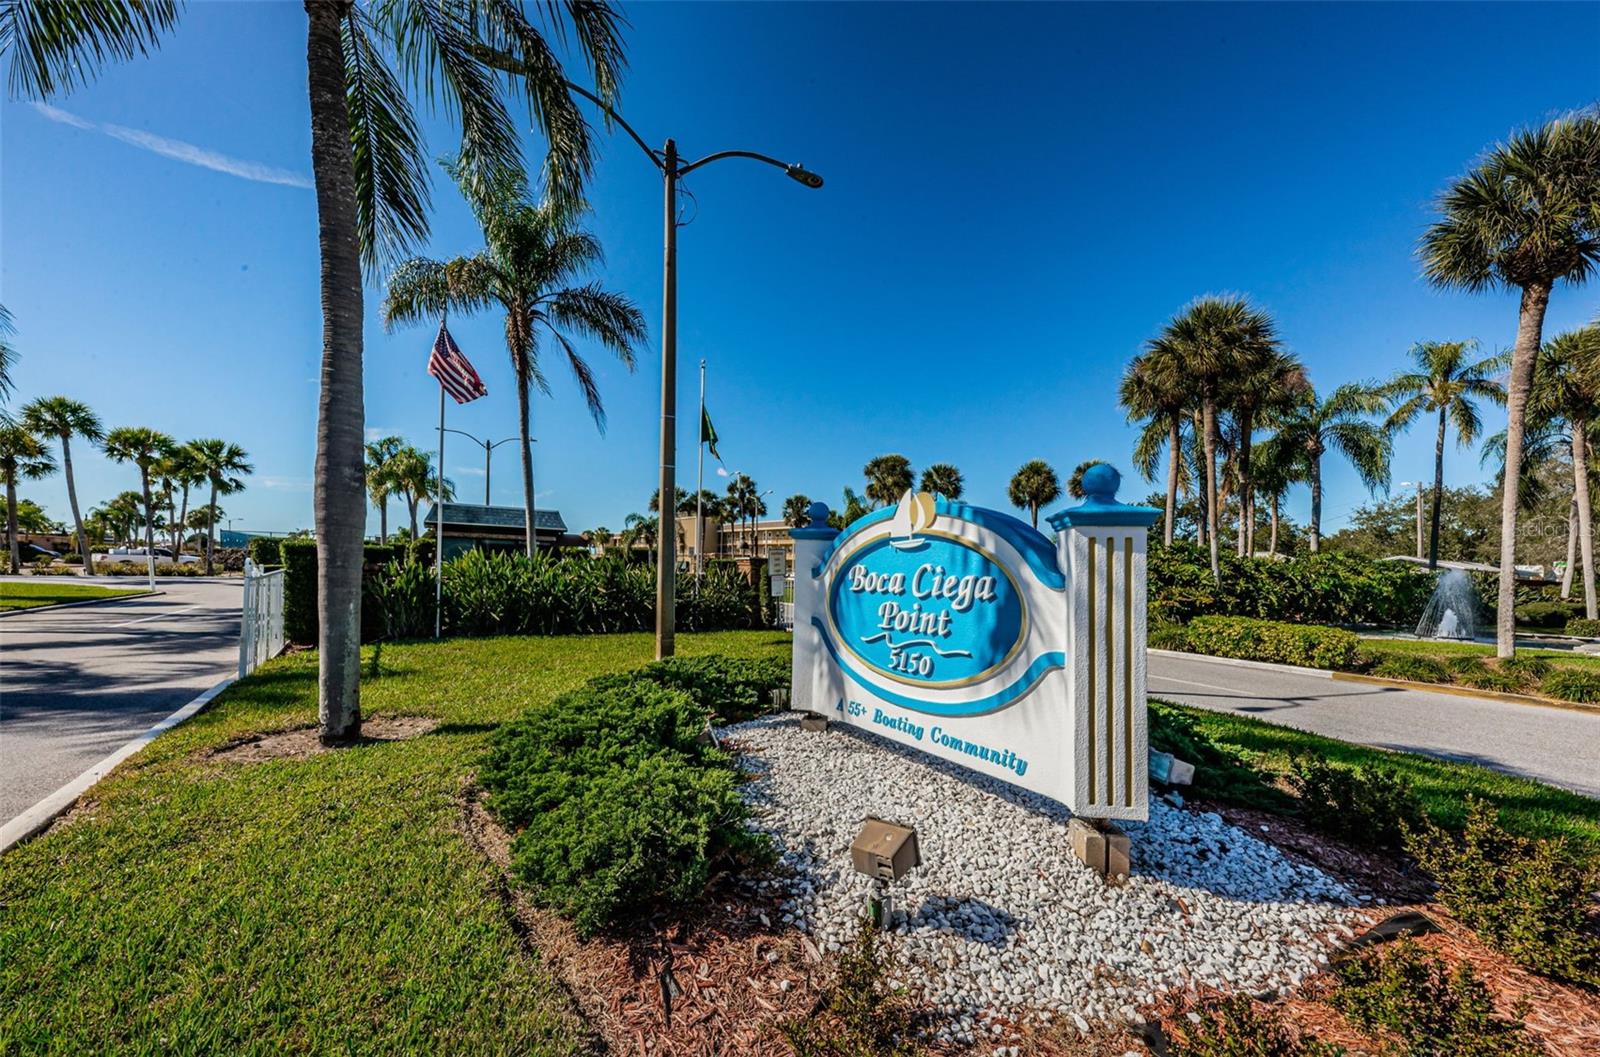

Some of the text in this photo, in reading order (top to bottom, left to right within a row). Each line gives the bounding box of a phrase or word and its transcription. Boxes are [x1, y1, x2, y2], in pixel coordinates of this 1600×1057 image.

[849, 563, 995, 611] Boca Ciega
[877, 600, 951, 637] Point
[888, 648, 933, 677] 5150
[836, 697, 1028, 776] A 55+ Boating Community
